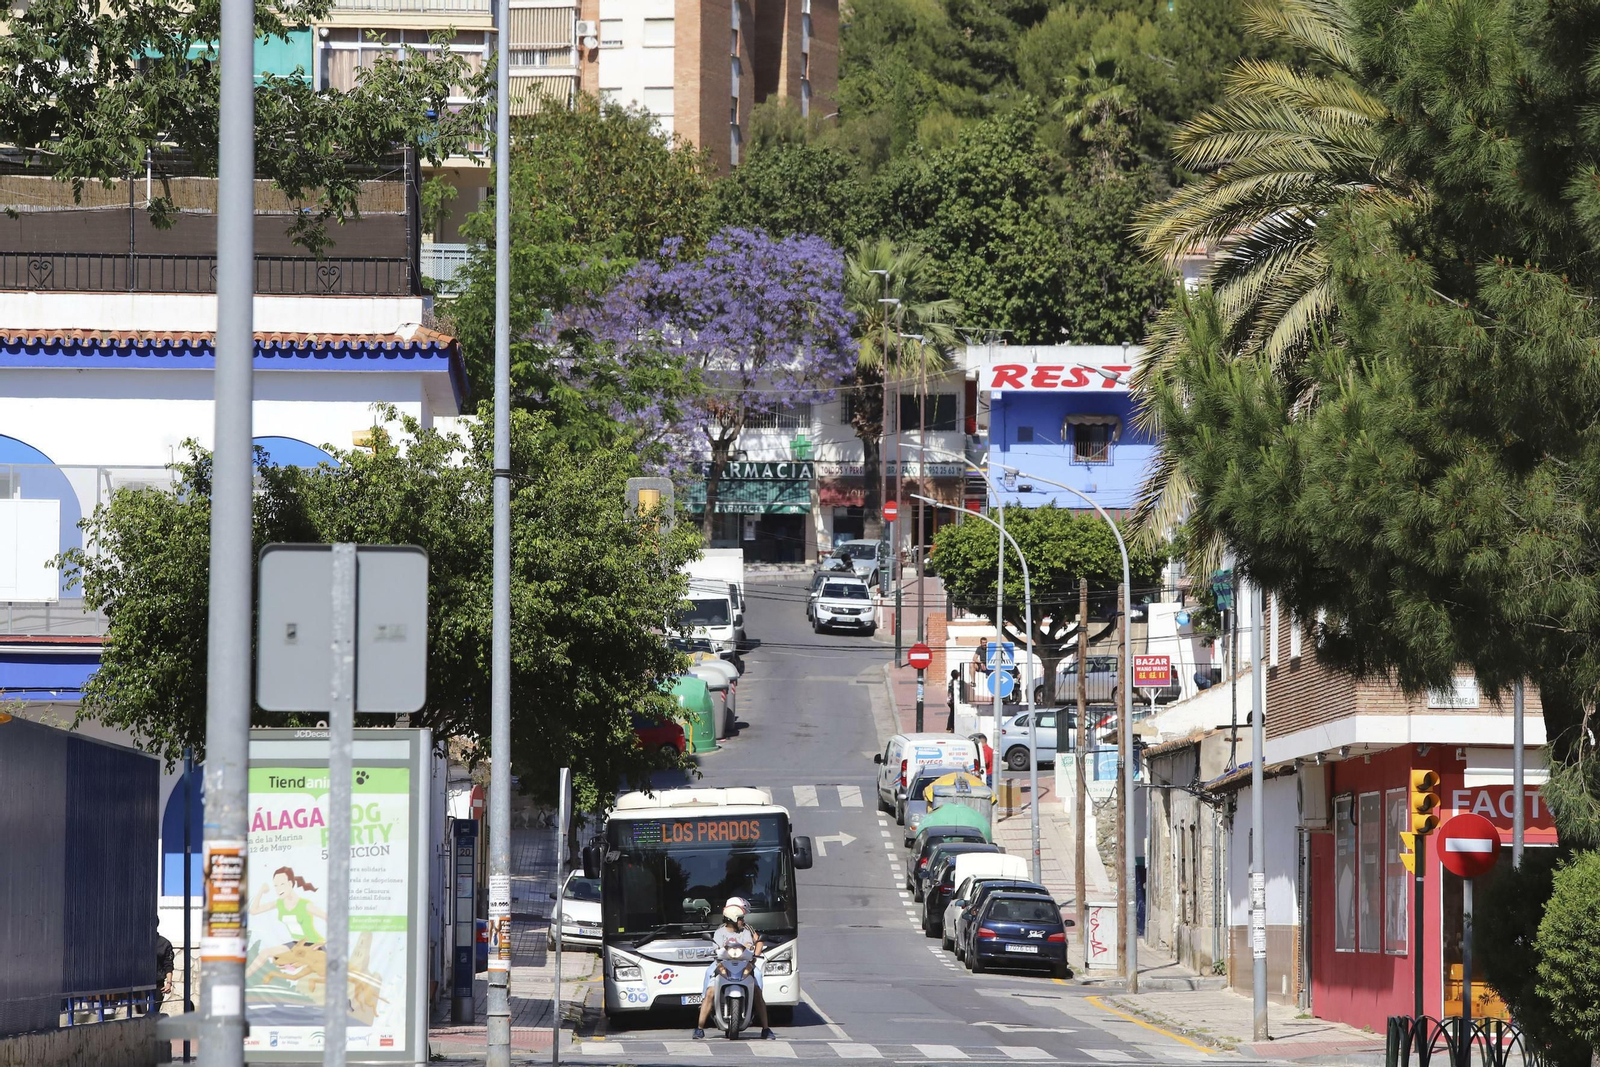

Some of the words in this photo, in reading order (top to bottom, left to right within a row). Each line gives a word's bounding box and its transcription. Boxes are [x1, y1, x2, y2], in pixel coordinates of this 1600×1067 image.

[991, 364, 1133, 389] REST
[702, 463, 812, 478] FRMACIA
[850, 466, 863, 475] PERS
[1136, 658, 1168, 666] BAZAR
[294, 730, 332, 738] JCDecau
[269, 776, 331, 789] Tiendani
[1452, 790, 1555, 818] FACT
[350, 802, 381, 825] OG
[275, 833, 303, 842] Marina
[320, 823, 393, 848] PRTY
[662, 822, 694, 842] LOS
[697, 820, 760, 841] PRADOS
[270, 844, 292, 854] Mayo
[351, 842, 390, 858] ICIÓN
[460, 848, 470, 857] 20
[677, 948, 715, 959] IVE
